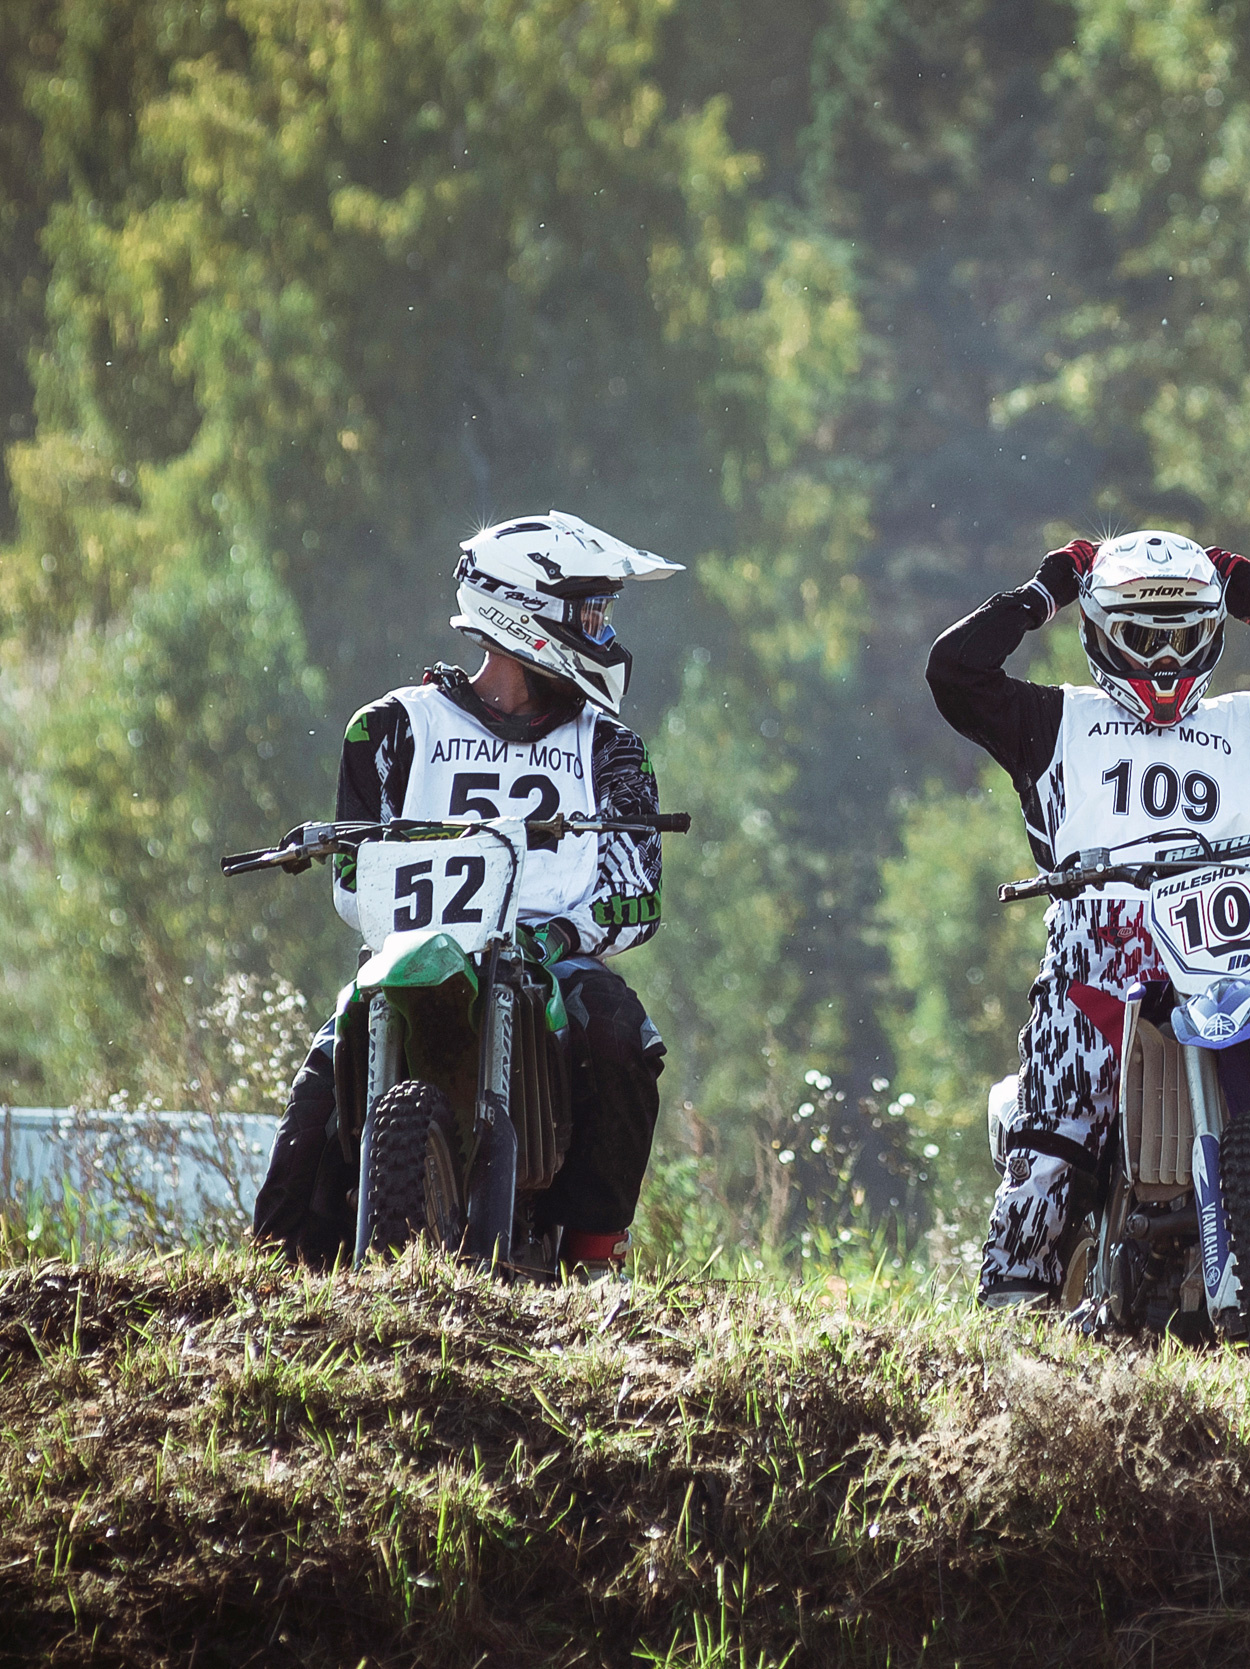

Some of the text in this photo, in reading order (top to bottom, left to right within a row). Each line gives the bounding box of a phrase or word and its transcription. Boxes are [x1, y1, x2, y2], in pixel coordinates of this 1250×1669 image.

[1139, 585, 1185, 599] THOR
[529, 743, 584, 779] МОТО
[1179, 726, 1232, 755] МОТО
[448, 772, 561, 854] 52
[1102, 759, 1220, 825] 109
[393, 856, 485, 932] 52
[1201, 1202, 1217, 1268] YAMAHA
